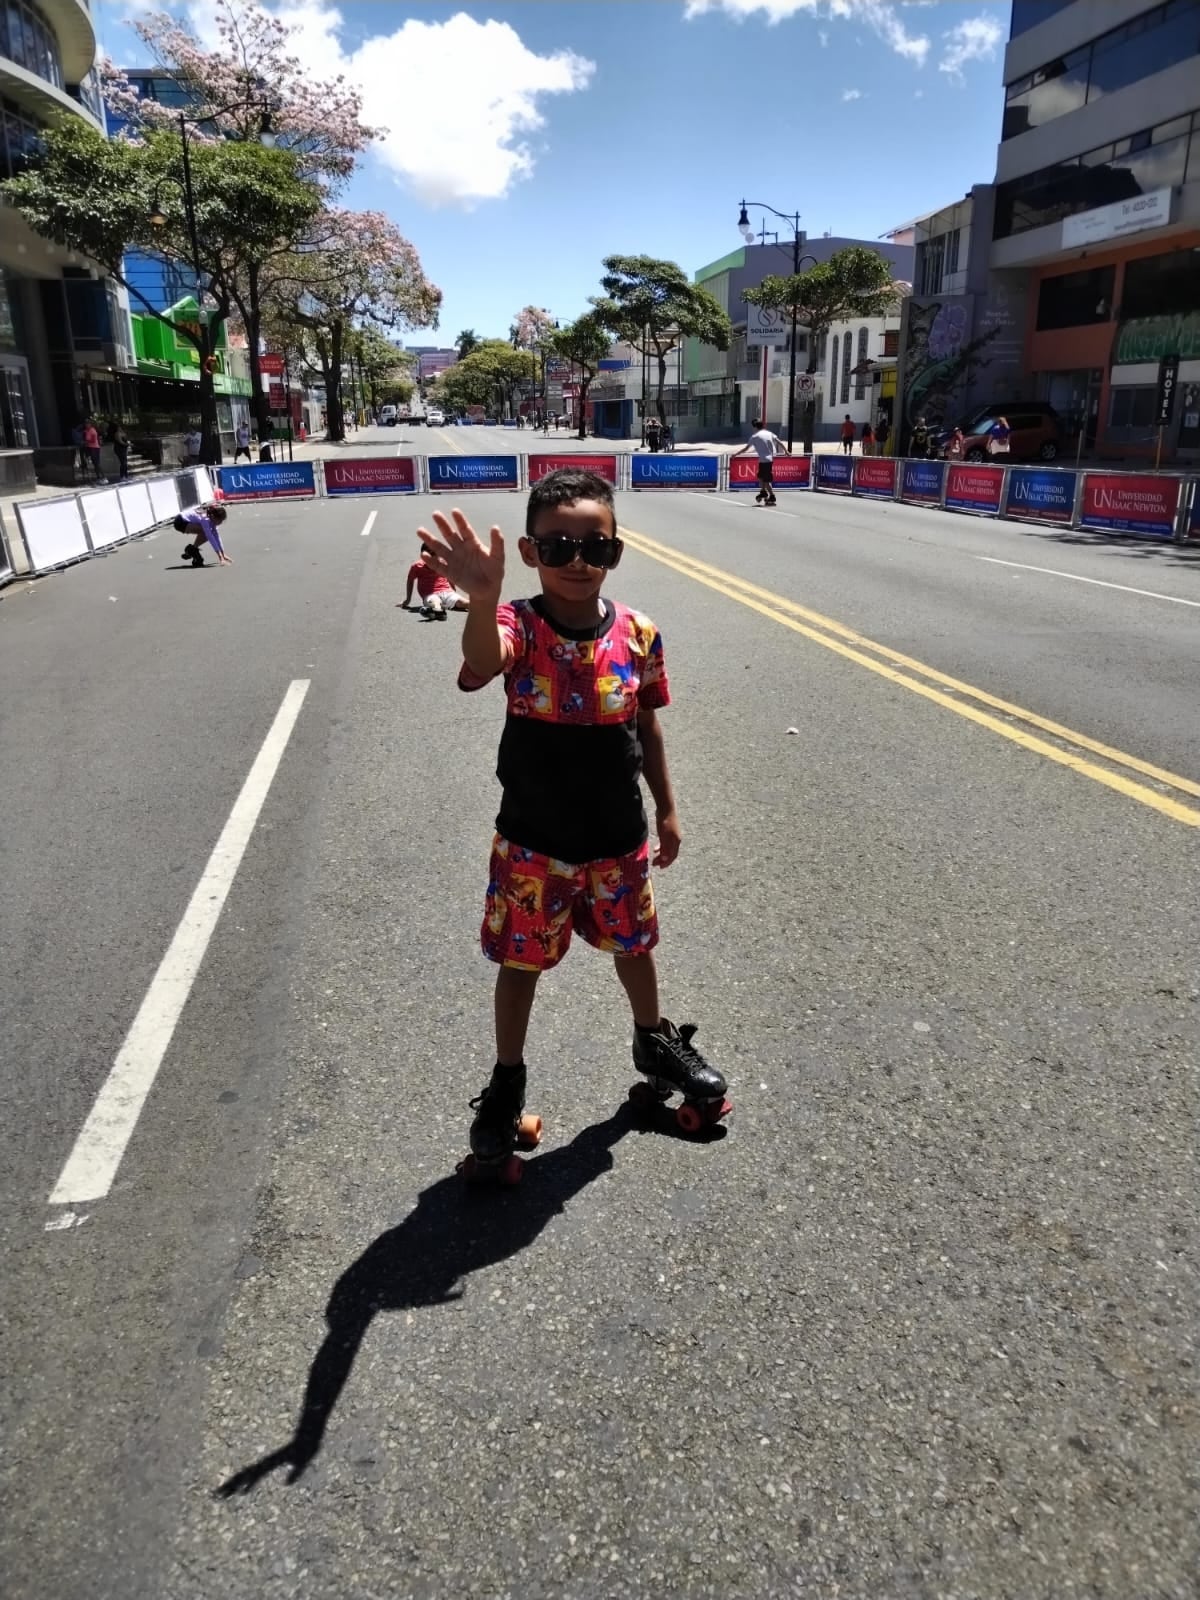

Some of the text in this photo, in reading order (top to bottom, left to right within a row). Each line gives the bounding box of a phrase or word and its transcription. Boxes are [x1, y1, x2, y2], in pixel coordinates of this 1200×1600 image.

[1161, 368, 1174, 418] HOTEL
[463, 464, 504, 472] UNIVERSIDAD
[256, 471, 300, 480] UNIVERSIDAD
[479, 470, 508, 478] NEWTON
[681, 470, 710, 478] NEWTON
[275, 477, 305, 486] NEWTON
[1032, 483, 1064, 494] UNIVERSIDAD
[1044, 494, 1067, 504] NEWTON
[1118, 490, 1163, 502] UNIVERSIDAD
[1112, 499, 1168, 513] ISAAC NEWTON
